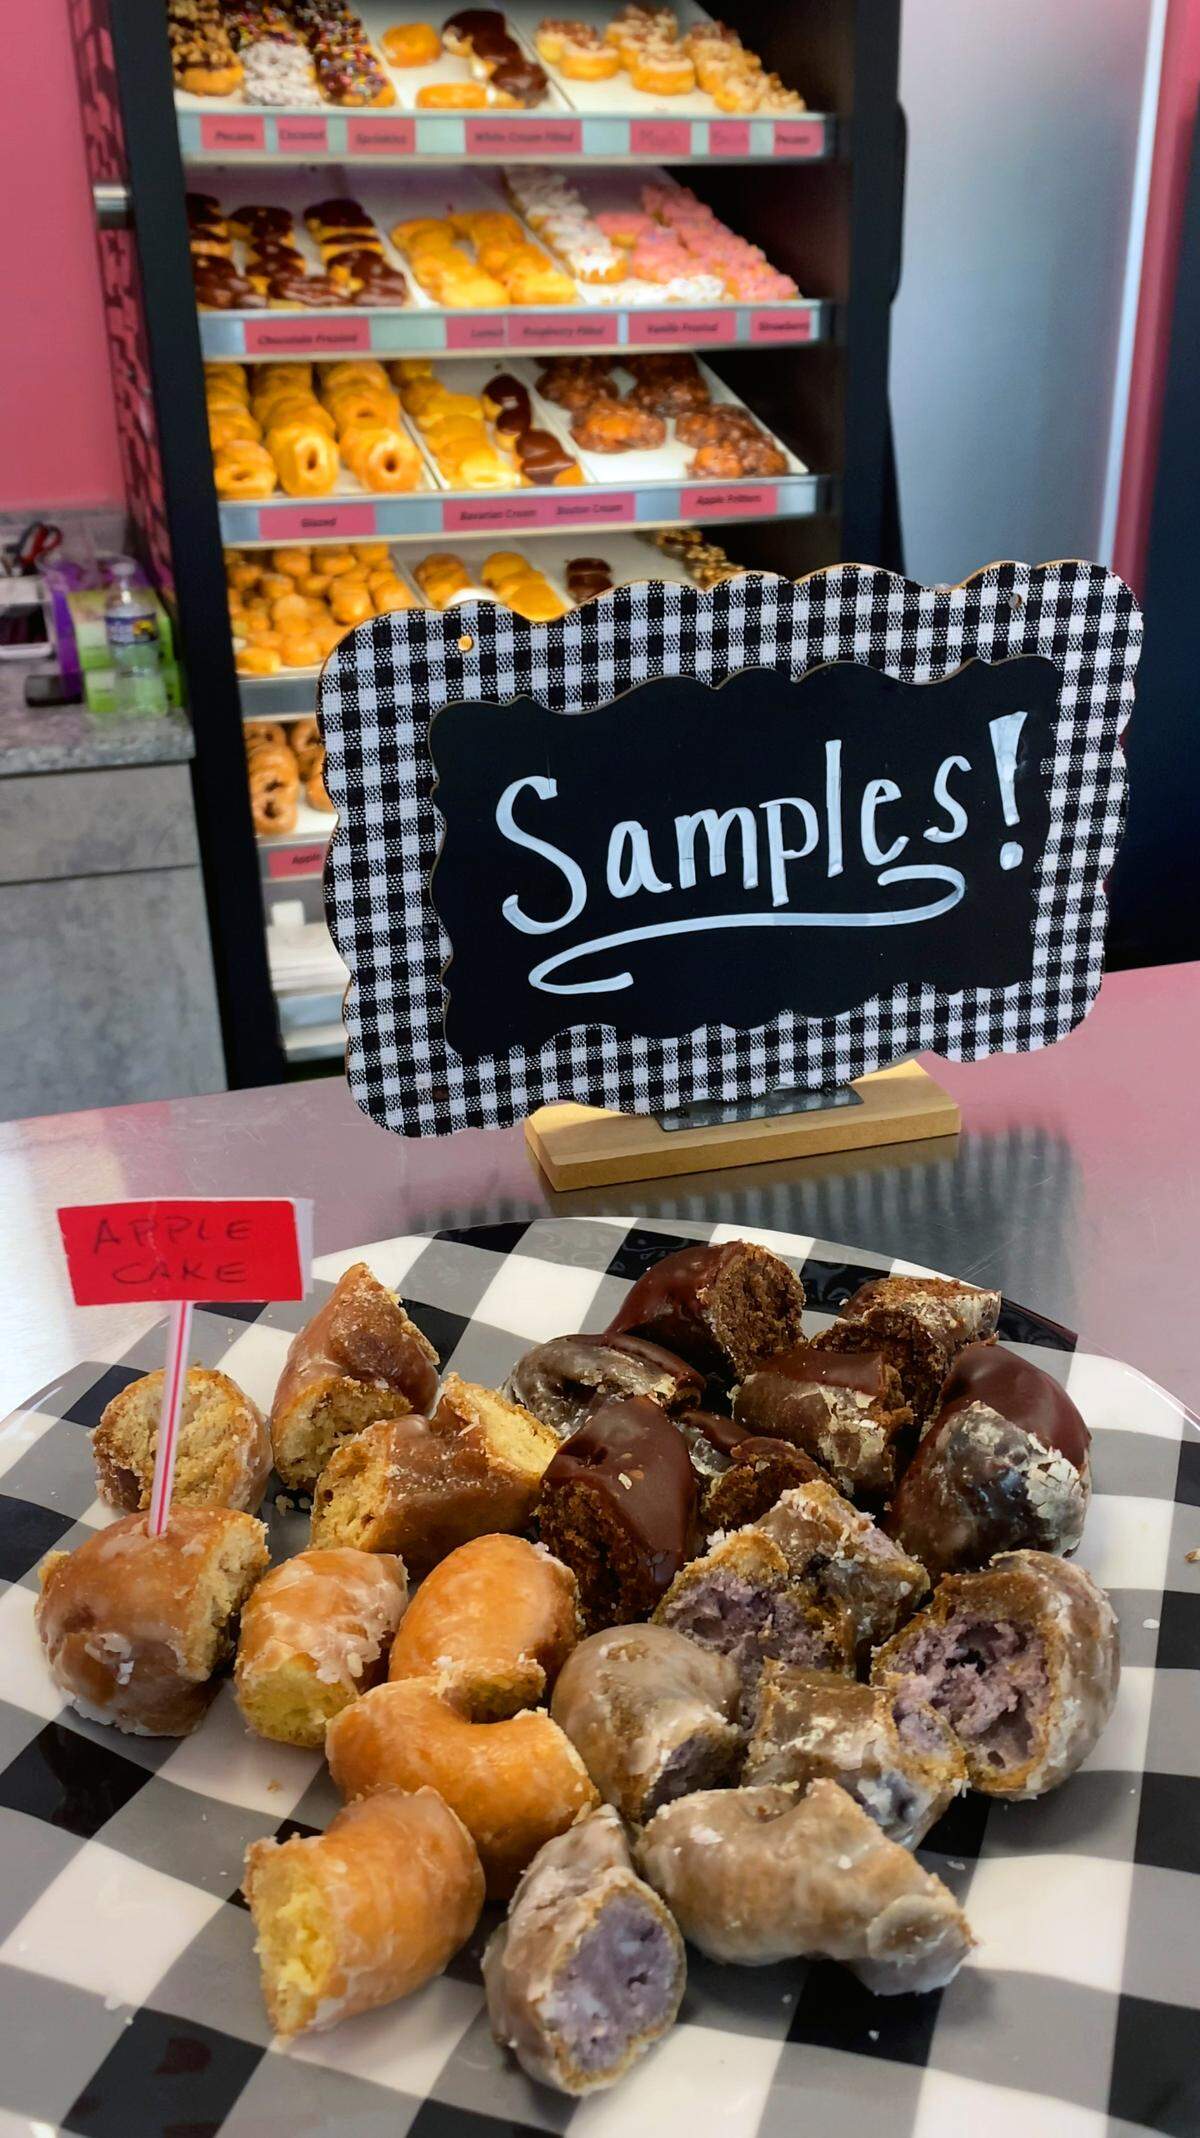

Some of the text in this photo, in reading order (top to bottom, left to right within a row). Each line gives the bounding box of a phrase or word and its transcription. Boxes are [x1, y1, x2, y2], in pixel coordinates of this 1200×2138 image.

[257, 335, 313, 345] Chocolate
[697, 496, 725, 506] Apple
[460, 508, 537, 521] Bavarian Cream
[557, 504, 623, 516] Boston Cream
[302, 518, 337, 528] Glazed
[495, 710, 1028, 935] Samples!
[93, 1216, 254, 1254] APPLE
[112, 1257, 247, 1285] CAKE
